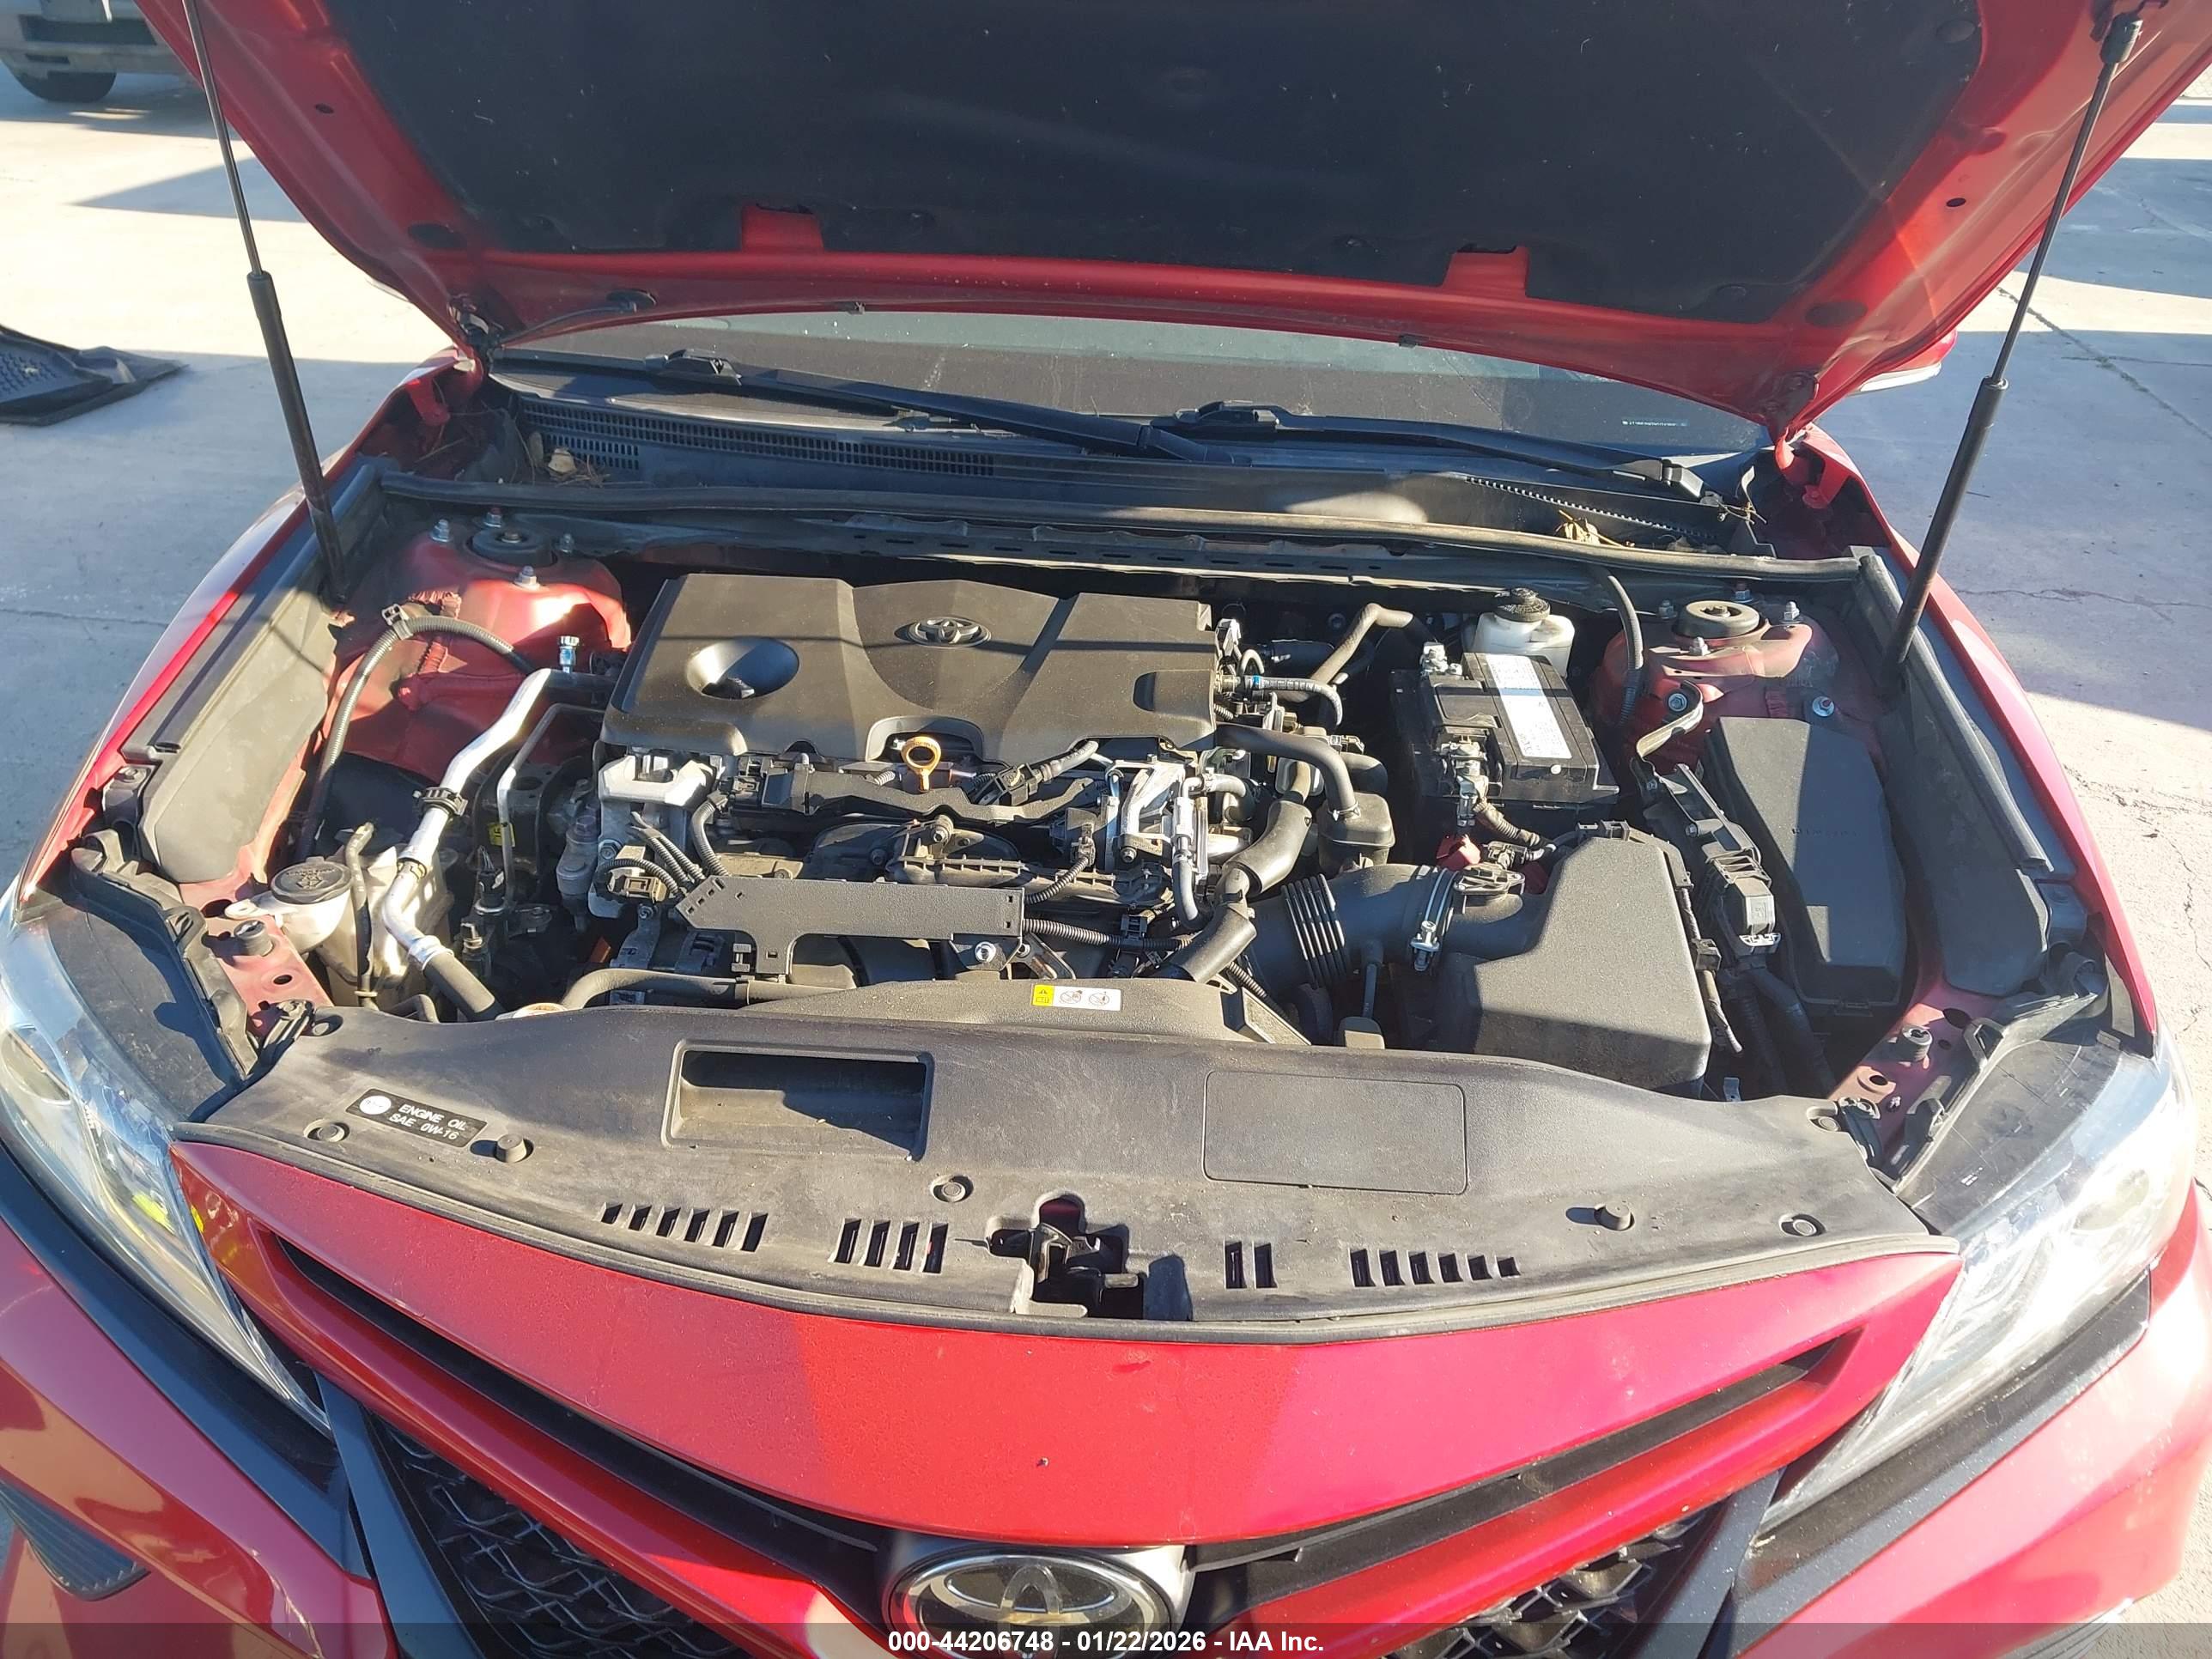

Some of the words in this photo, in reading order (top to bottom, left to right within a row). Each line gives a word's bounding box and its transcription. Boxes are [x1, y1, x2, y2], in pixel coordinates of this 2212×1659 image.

[389, 1114, 416, 1127] SAE
[421, 1123, 459, 1139] 0W-16
[398, 1104, 445, 1123] ENGINE
[447, 1119, 467, 1131] OIL
